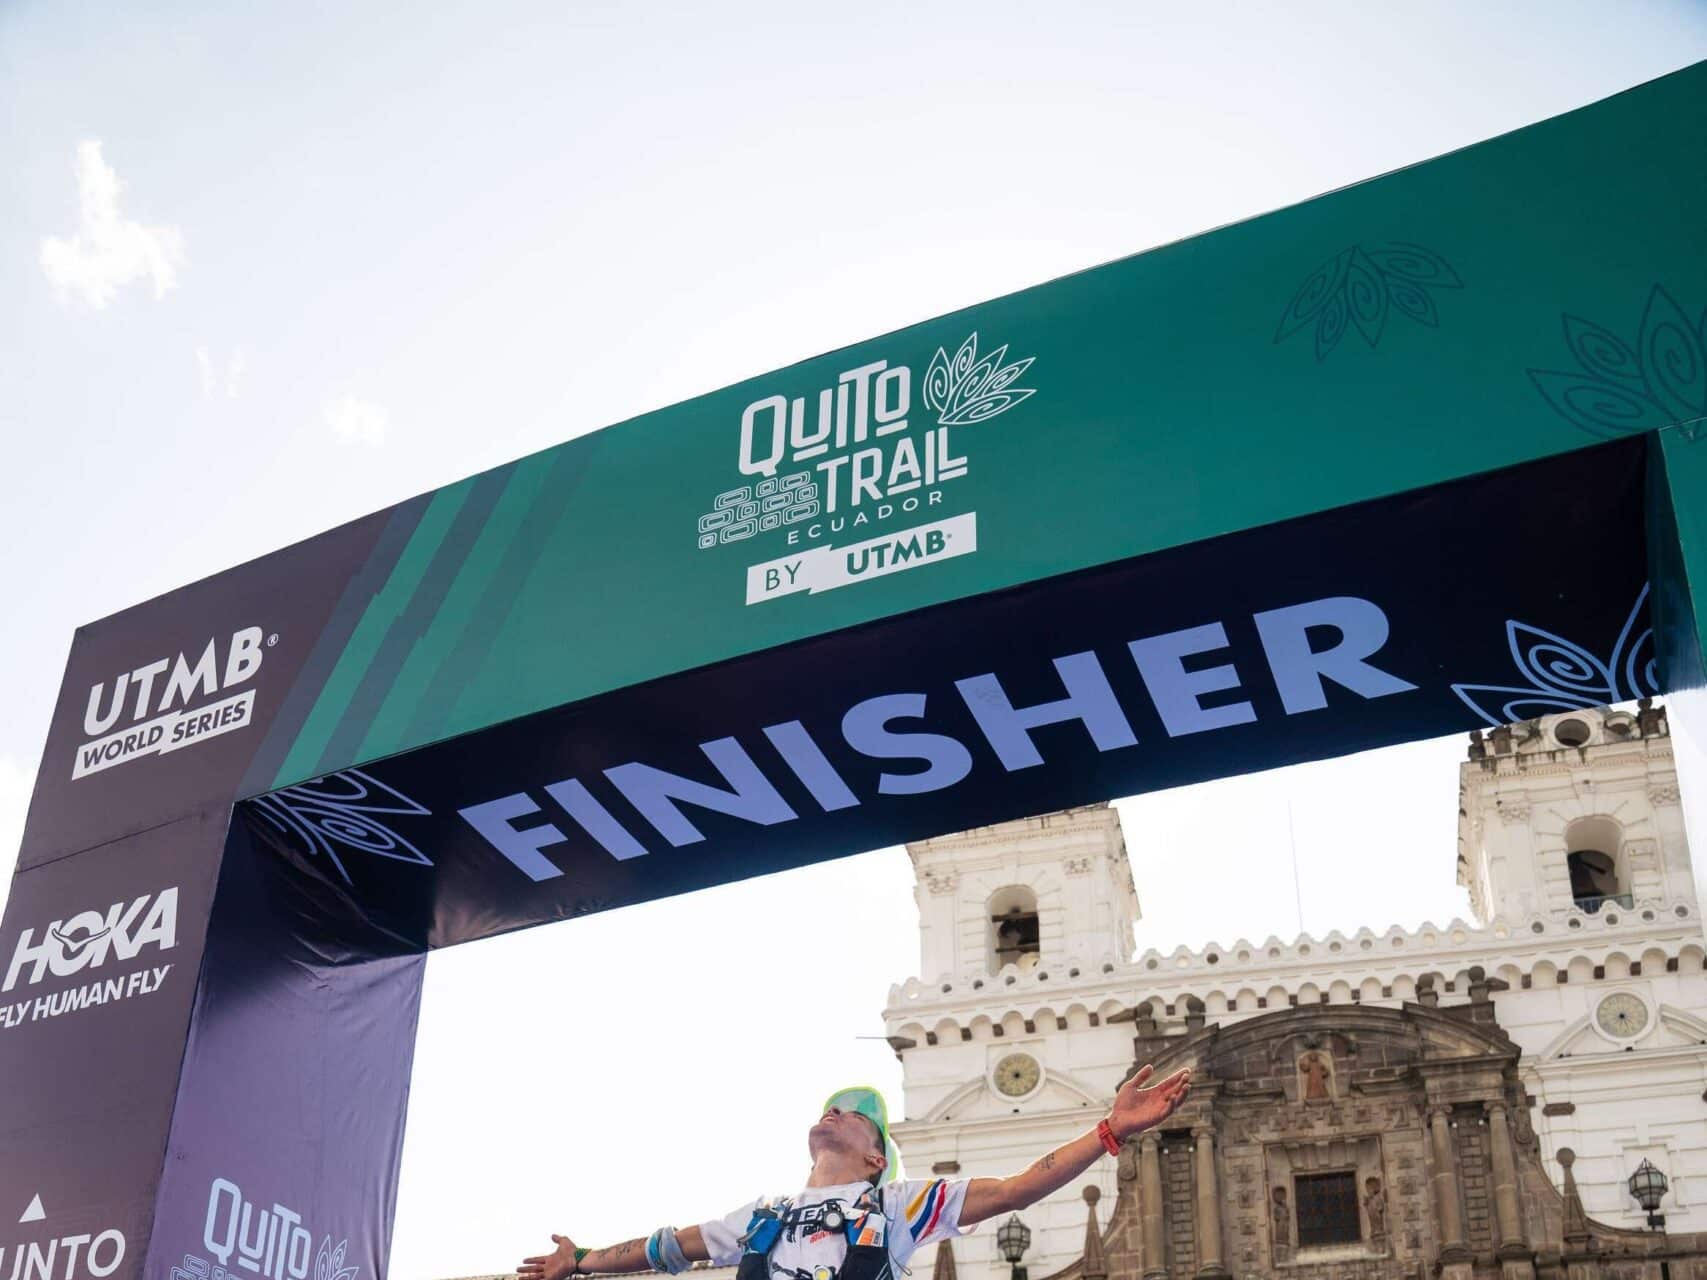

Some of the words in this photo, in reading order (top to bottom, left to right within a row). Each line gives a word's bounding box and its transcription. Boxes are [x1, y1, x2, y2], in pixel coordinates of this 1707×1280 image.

[817, 426, 968, 513] TRAIL
[787, 490, 943, 545] ECUADOR
[765, 561, 802, 591] BY
[847, 530, 946, 577] UTMB
[83, 724, 164, 769] WORLD
[171, 700, 247, 743] SERIES
[457, 596, 1419, 883] FINISHER
[1, 887, 178, 992] HOKA
[0, 1000, 32, 1028] FLY
[32, 976, 125, 1021] HUMAN
[126, 964, 170, 998] FLY
